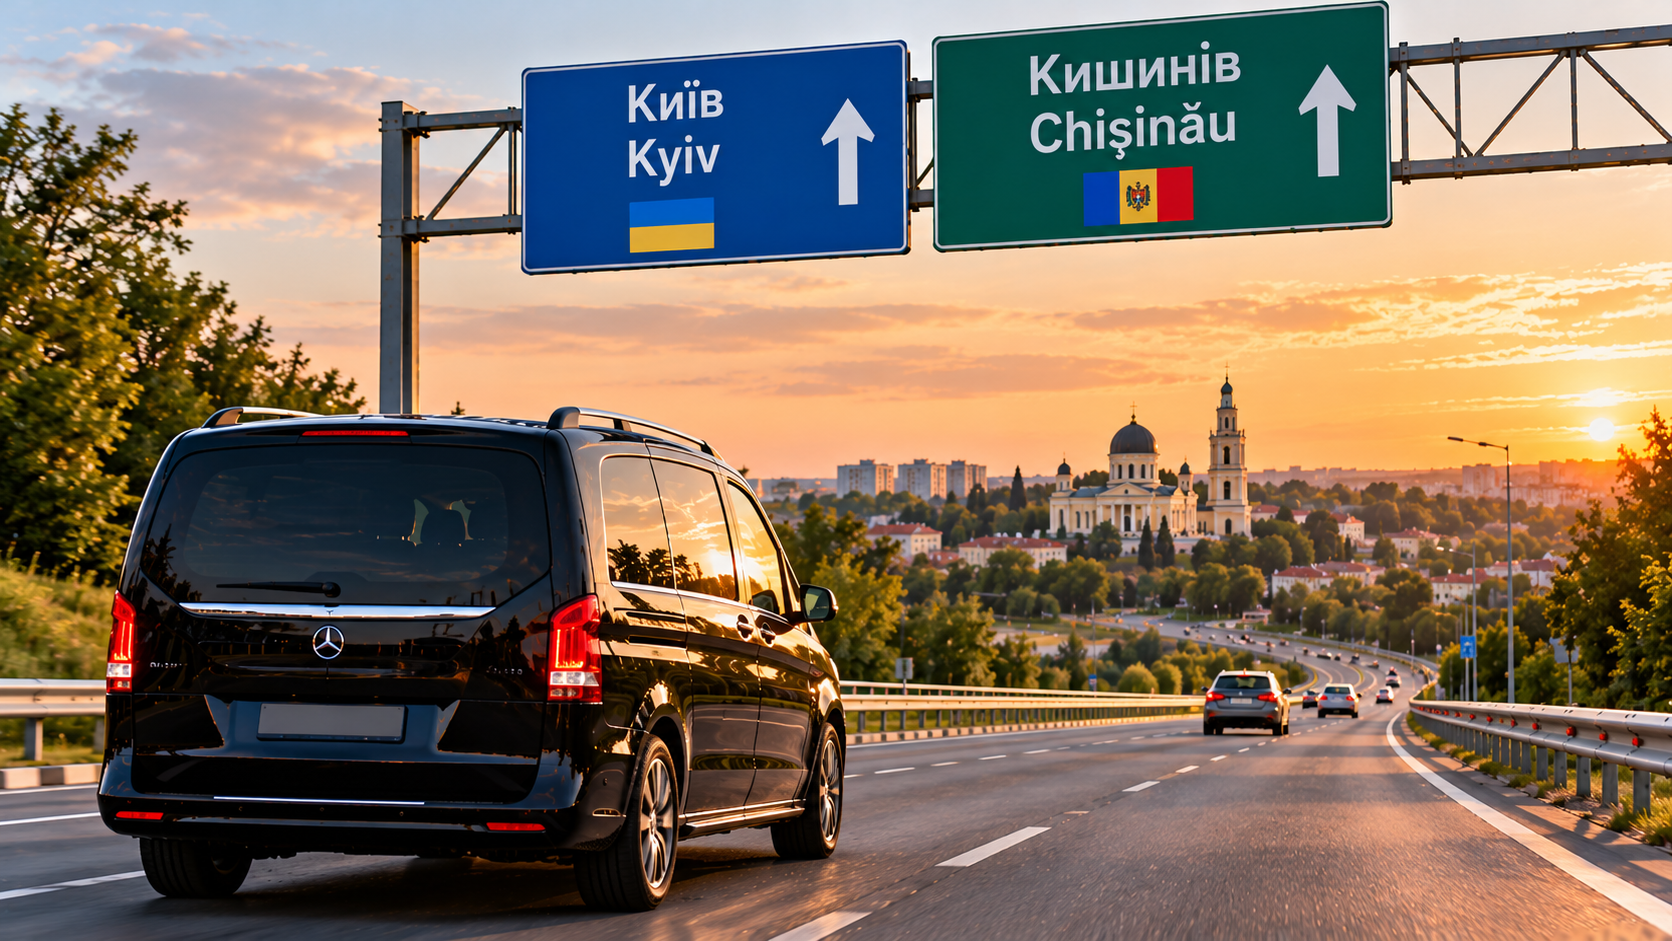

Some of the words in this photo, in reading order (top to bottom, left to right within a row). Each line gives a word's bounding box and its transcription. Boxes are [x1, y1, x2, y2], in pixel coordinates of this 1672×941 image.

[1030, 40, 1242, 95] Кишинів
[628, 79, 725, 123] Київ
[628, 134, 721, 187] Kyiv
